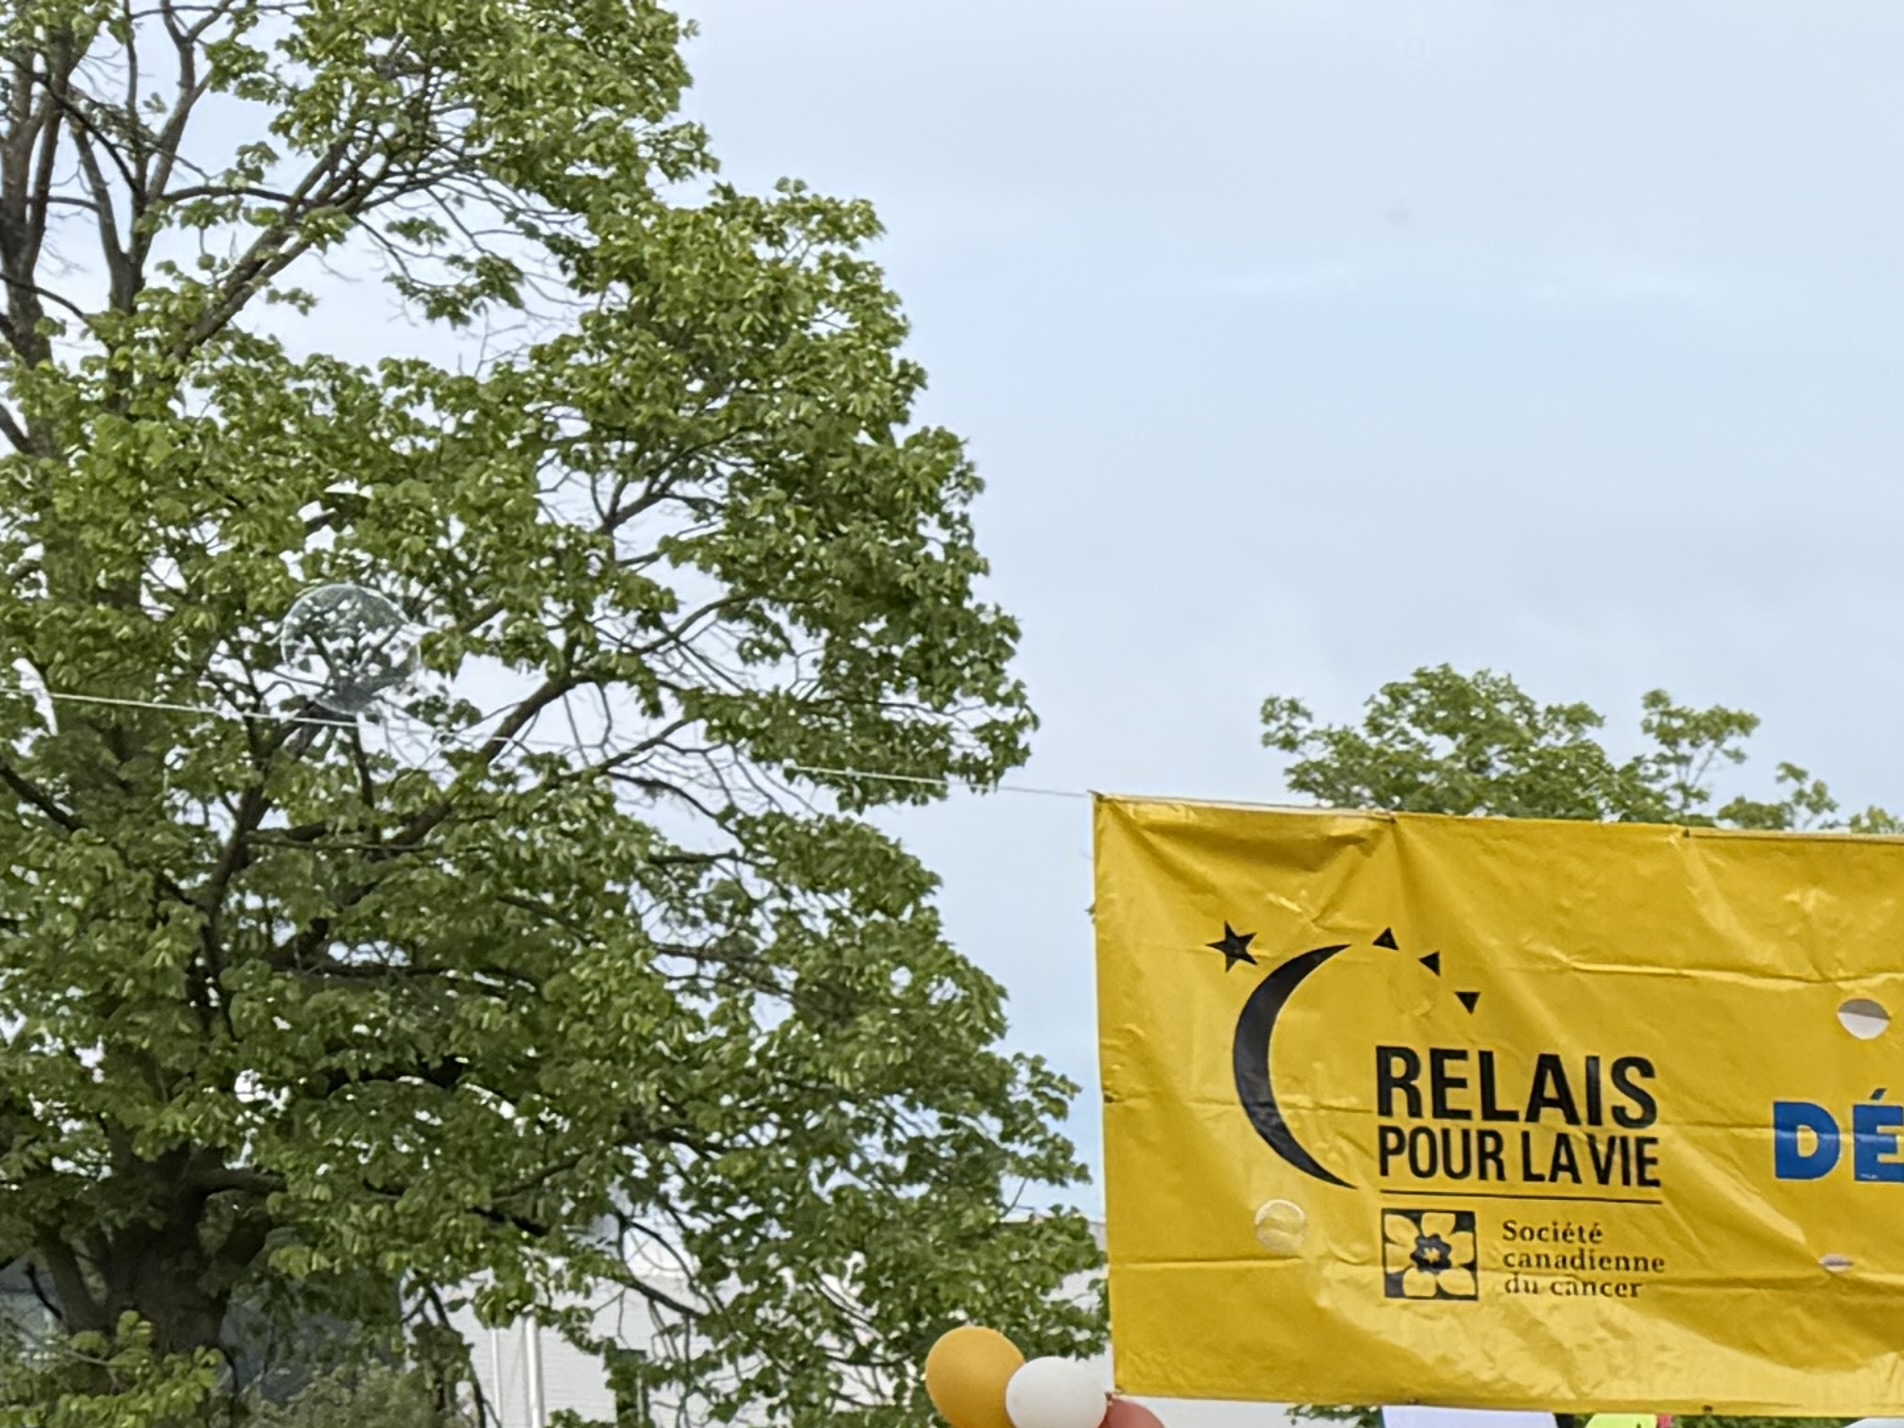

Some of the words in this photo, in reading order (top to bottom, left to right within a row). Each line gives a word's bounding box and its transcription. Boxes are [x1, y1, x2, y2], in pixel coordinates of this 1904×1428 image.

[1375, 1045, 1658, 1129] RELAIS
[1378, 1125, 1506, 1182] POUR
[1502, 1219, 1604, 1245] Société
[1503, 1248, 1666, 1274] canadienne
[1505, 1272, 1539, 1296] du
[1550, 1277, 1643, 1299] cancer
